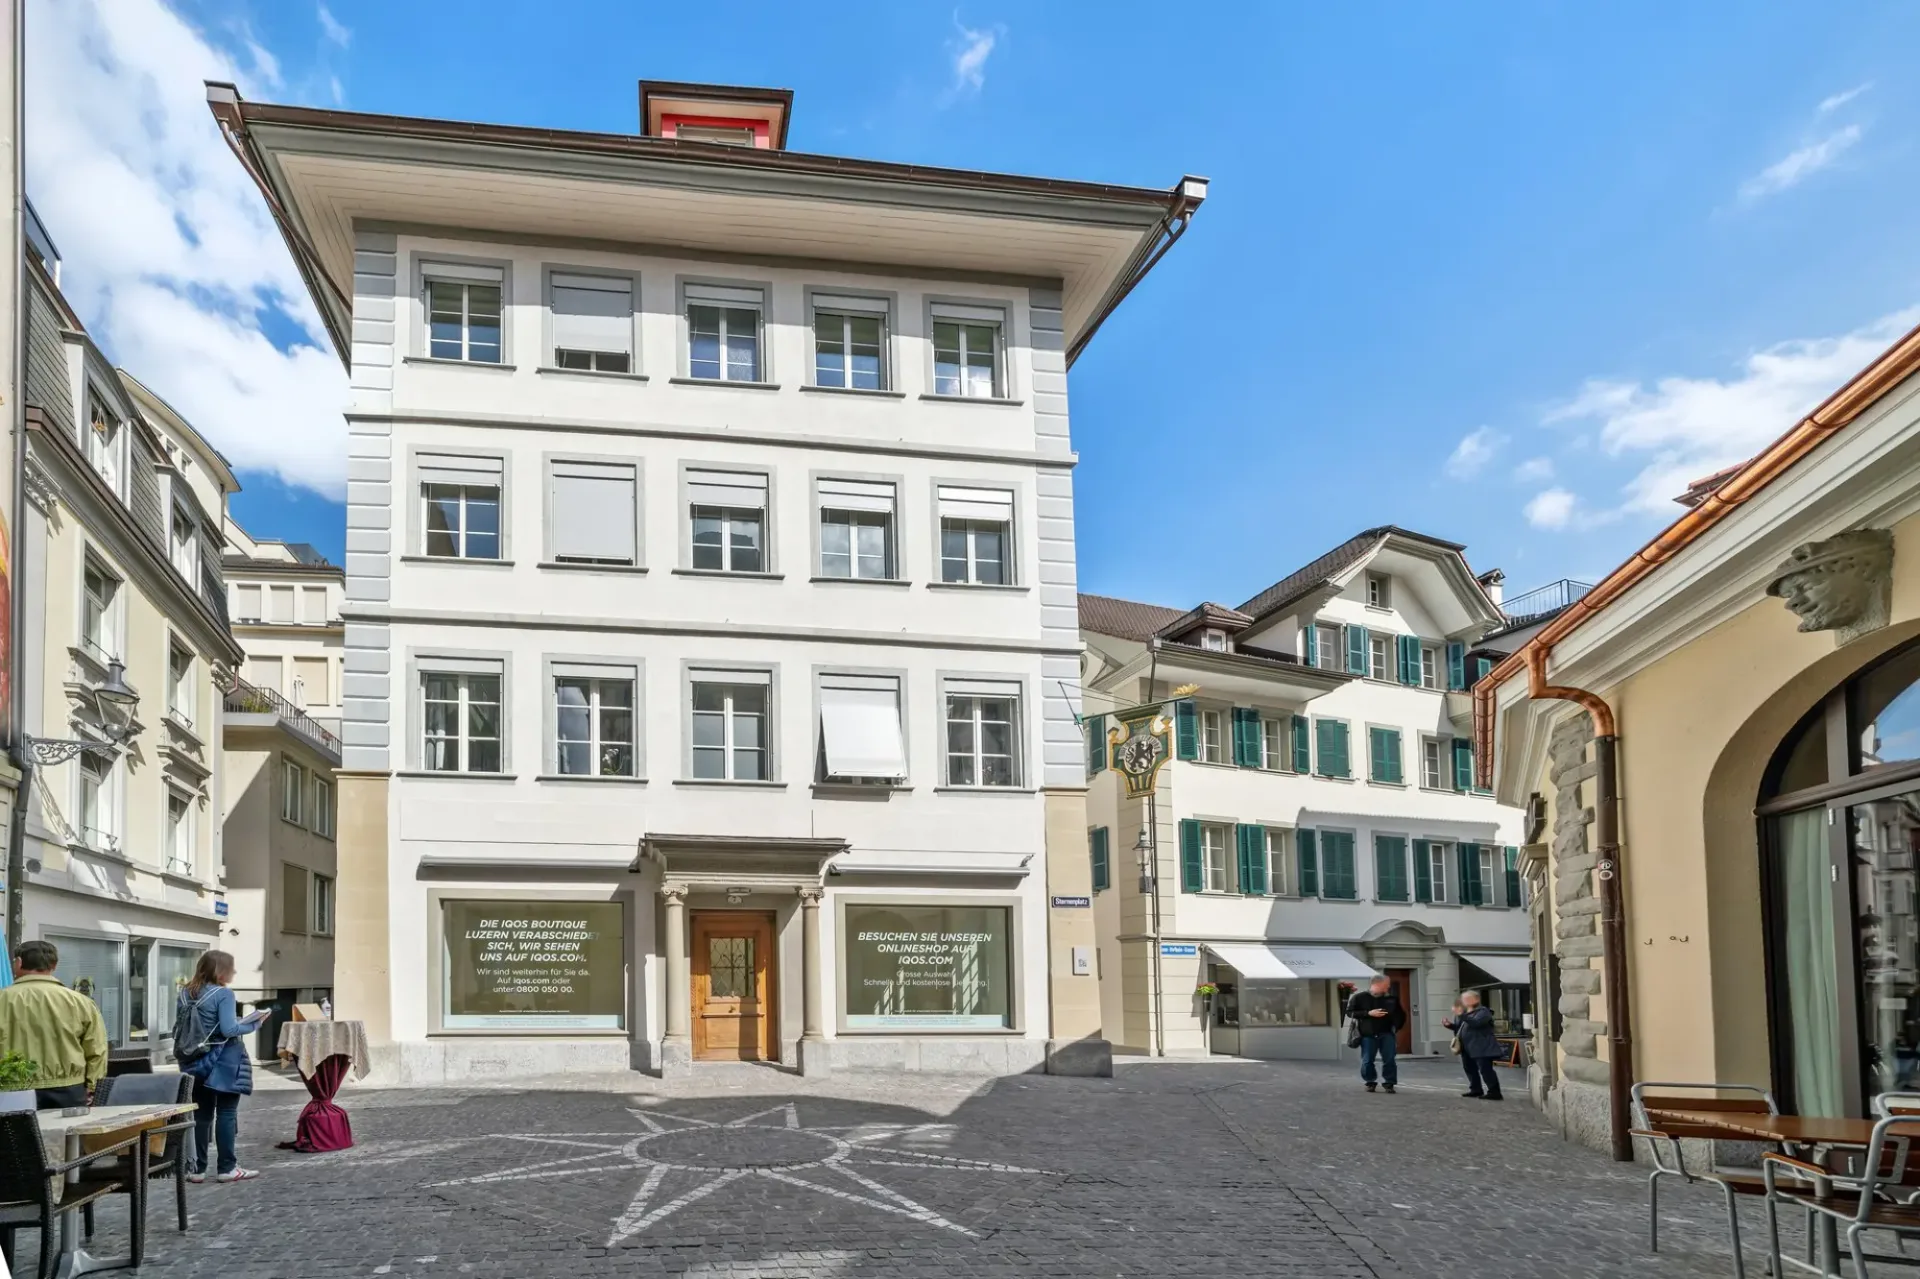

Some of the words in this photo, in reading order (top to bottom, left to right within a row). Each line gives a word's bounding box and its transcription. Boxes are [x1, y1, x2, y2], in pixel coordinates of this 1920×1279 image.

[480, 919, 499, 929] DIE
[501, 919, 529, 929] IQOS
[531, 920, 588, 930] BOUTIQUE
[465, 930, 510, 939] LUZERN
[858, 931, 919, 941] BESUCHEN
[920, 932, 938, 942] SIE
[940, 933, 993, 943] UNSEREN
[487, 941, 516, 952] SICH,
[519, 942, 541, 951] WIR
[543, 942, 581, 951] SEHEN
[877, 944, 949, 954] ONLINESHOP
[480, 953, 502, 962] UNS
[505, 953, 529, 962] AUF
[530, 953, 588, 963] IQOS.COM.
[898, 955, 954, 965] IQOS.COM
[564, 968, 576, 976] Sie
[578, 968, 591, 976] da.
[513, 977, 550, 986] iqos.com
[912, 979, 951, 987] kostenlose
